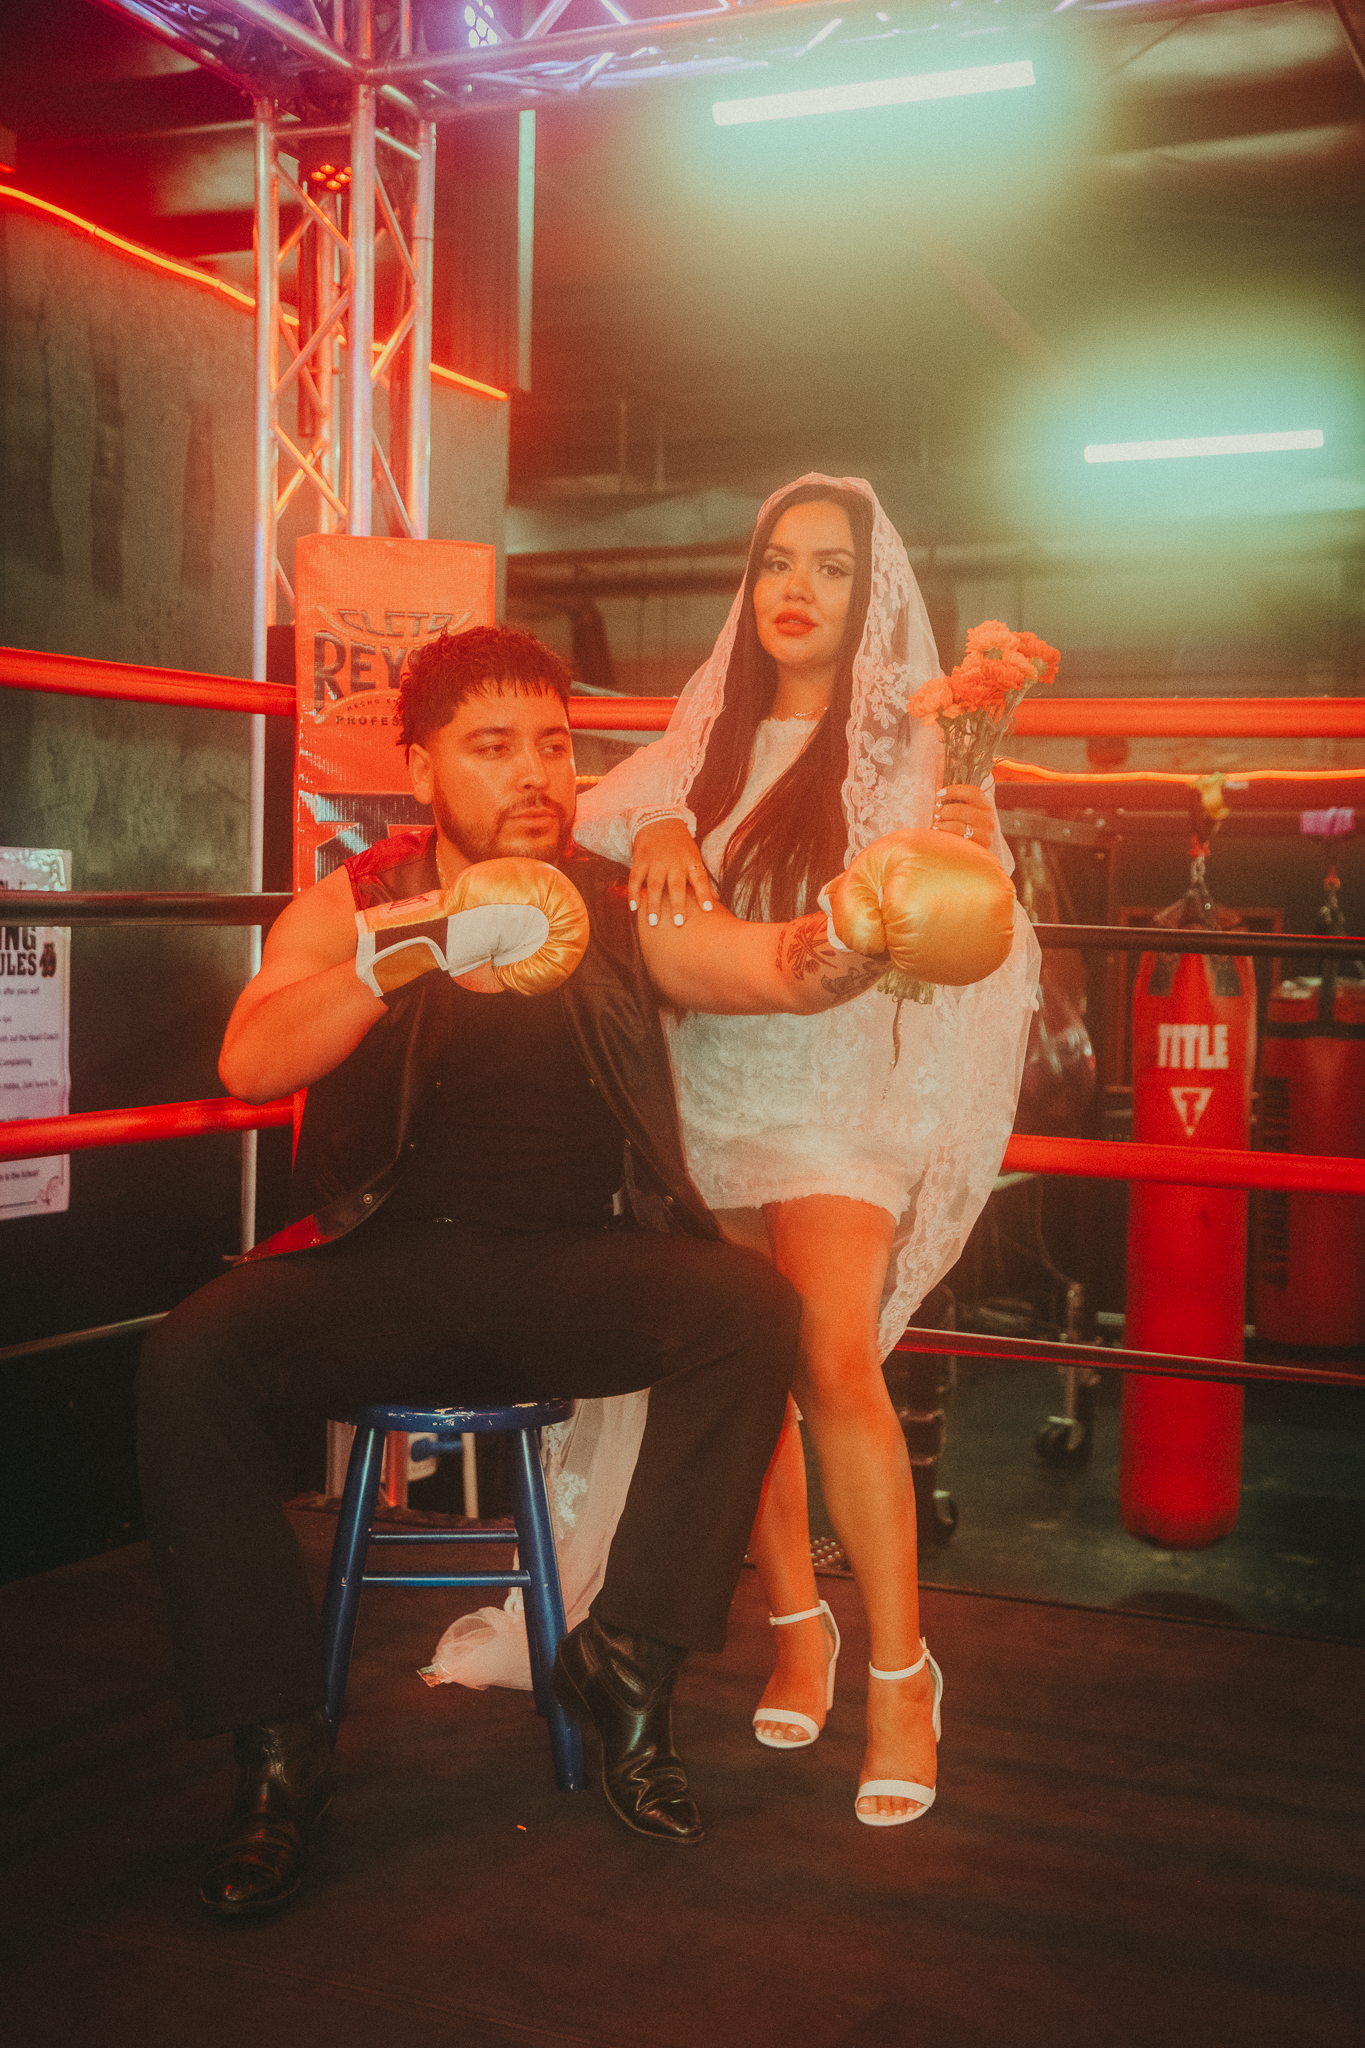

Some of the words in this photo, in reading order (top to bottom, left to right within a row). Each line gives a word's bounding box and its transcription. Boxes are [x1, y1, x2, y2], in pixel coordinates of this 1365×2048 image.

[314, 630, 408, 712] REY
[335, 715, 402, 727] PROFES
[0, 952, 37, 976] ULES
[1158, 1023, 1229, 1070] TITLE
